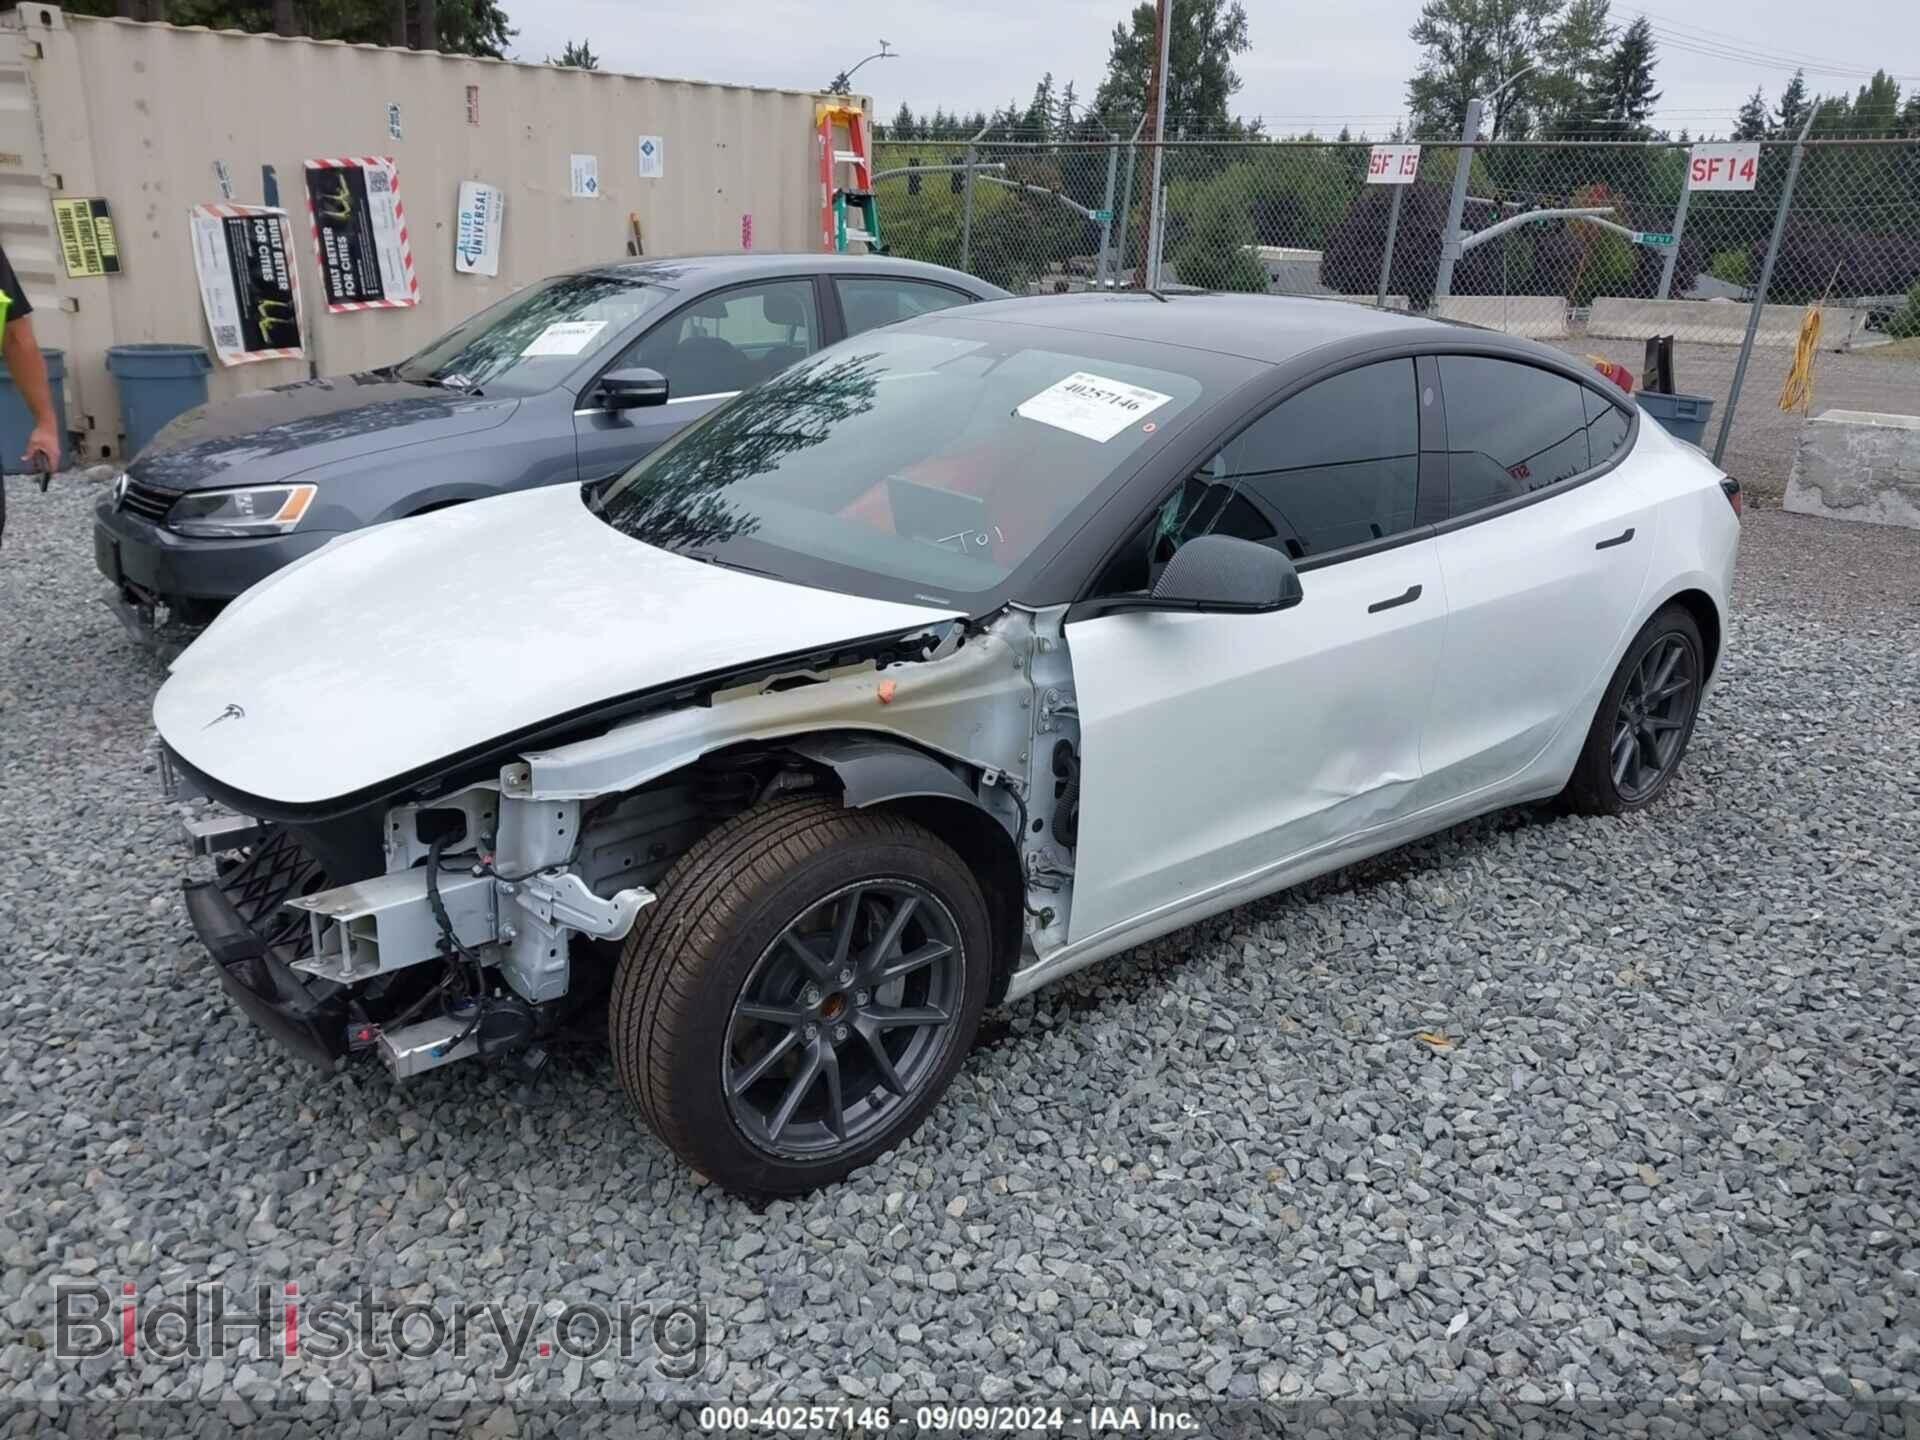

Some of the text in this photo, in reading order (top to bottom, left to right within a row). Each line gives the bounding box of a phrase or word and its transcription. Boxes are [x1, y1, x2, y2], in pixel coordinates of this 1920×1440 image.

[1370, 154, 1418, 175] SF 15
[1692, 157, 1754, 182] SF 14
[58, 207, 83, 269] FREQUENT STOPS
[73, 201, 102, 274] THIS VEHICLE MAKES
[95, 216, 117, 256] CAUTION
[253, 218, 274, 282] FOR CITIES
[267, 218, 289, 290] BUILT BETTER
[458, 211, 473, 253] ALLIED
[470, 191, 487, 255] UNIVERSAL
[322, 226, 344, 297] BUILT BETTER
[337, 235, 356, 297] FOR CITIES
[1063, 383, 1141, 411] 40257146
